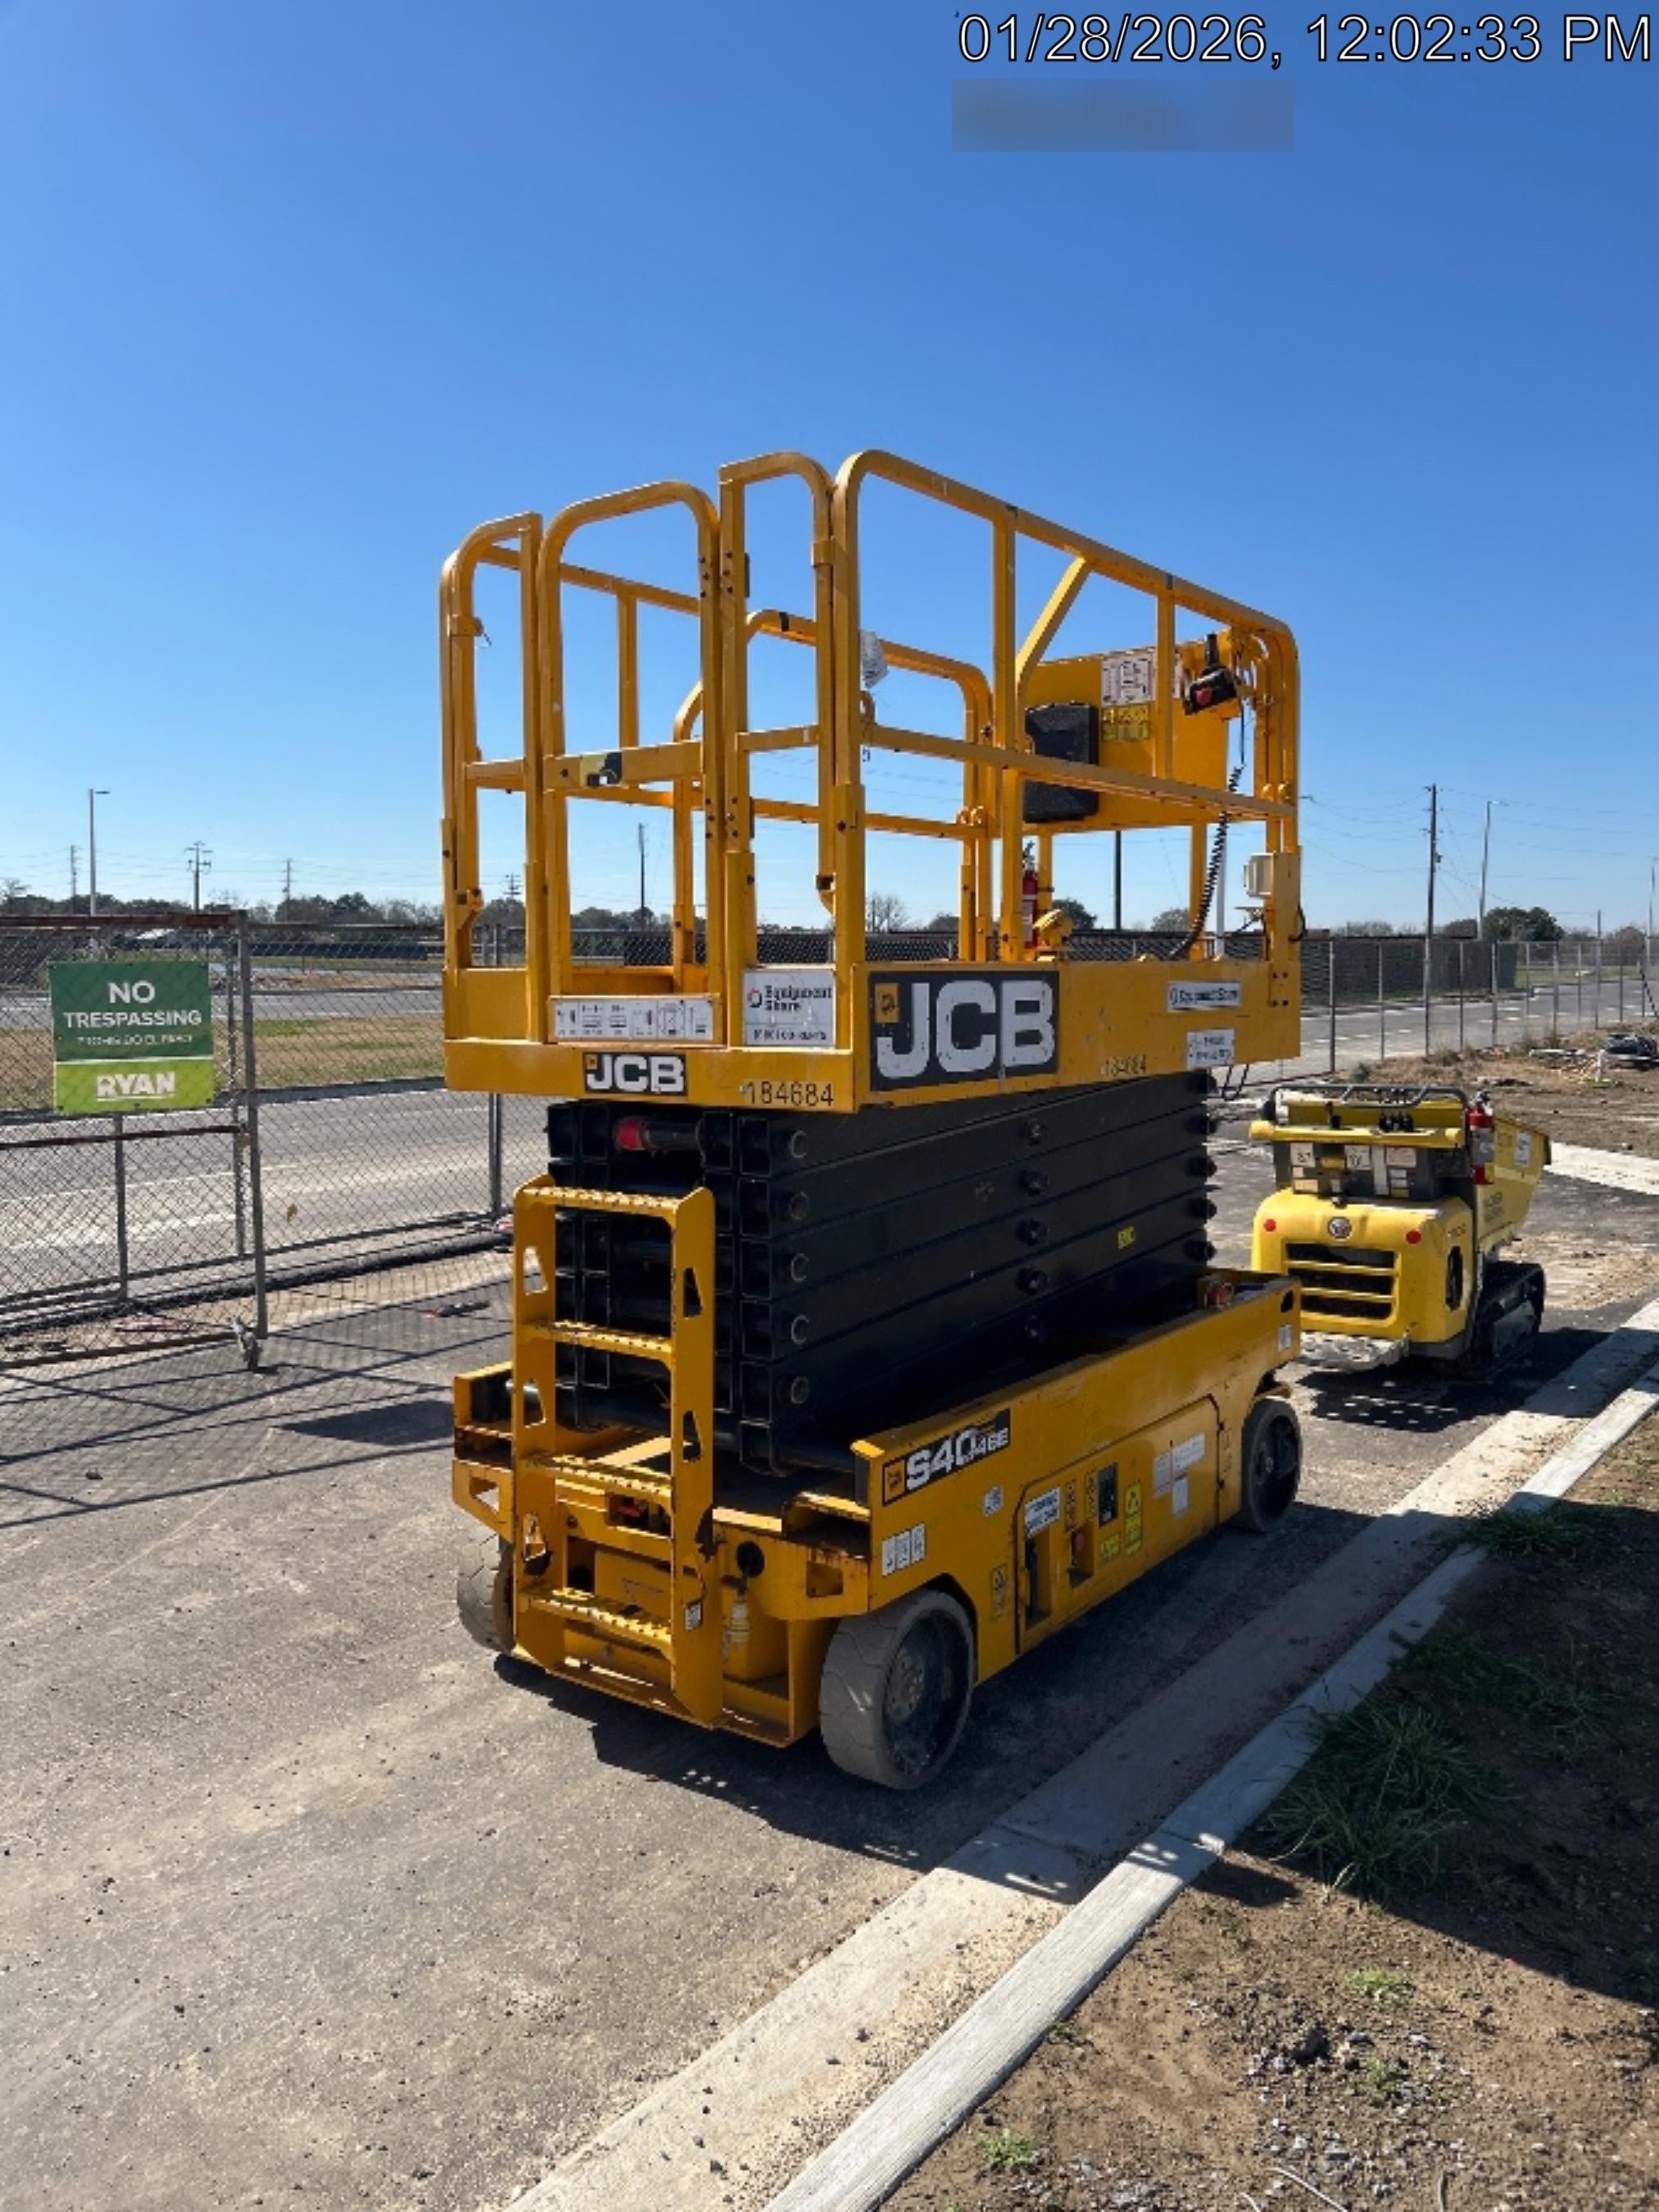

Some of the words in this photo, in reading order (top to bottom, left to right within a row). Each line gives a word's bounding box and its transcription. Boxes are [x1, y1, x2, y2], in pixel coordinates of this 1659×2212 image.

[108, 981, 156, 1004] NO
[63, 1009, 202, 1028] TRESPASSING
[876, 980, 1055, 1079] JCB
[97, 1072, 175, 1098] RYAN
[586, 1054, 685, 1093] JCB
[746, 1081, 834, 1107] 184684
